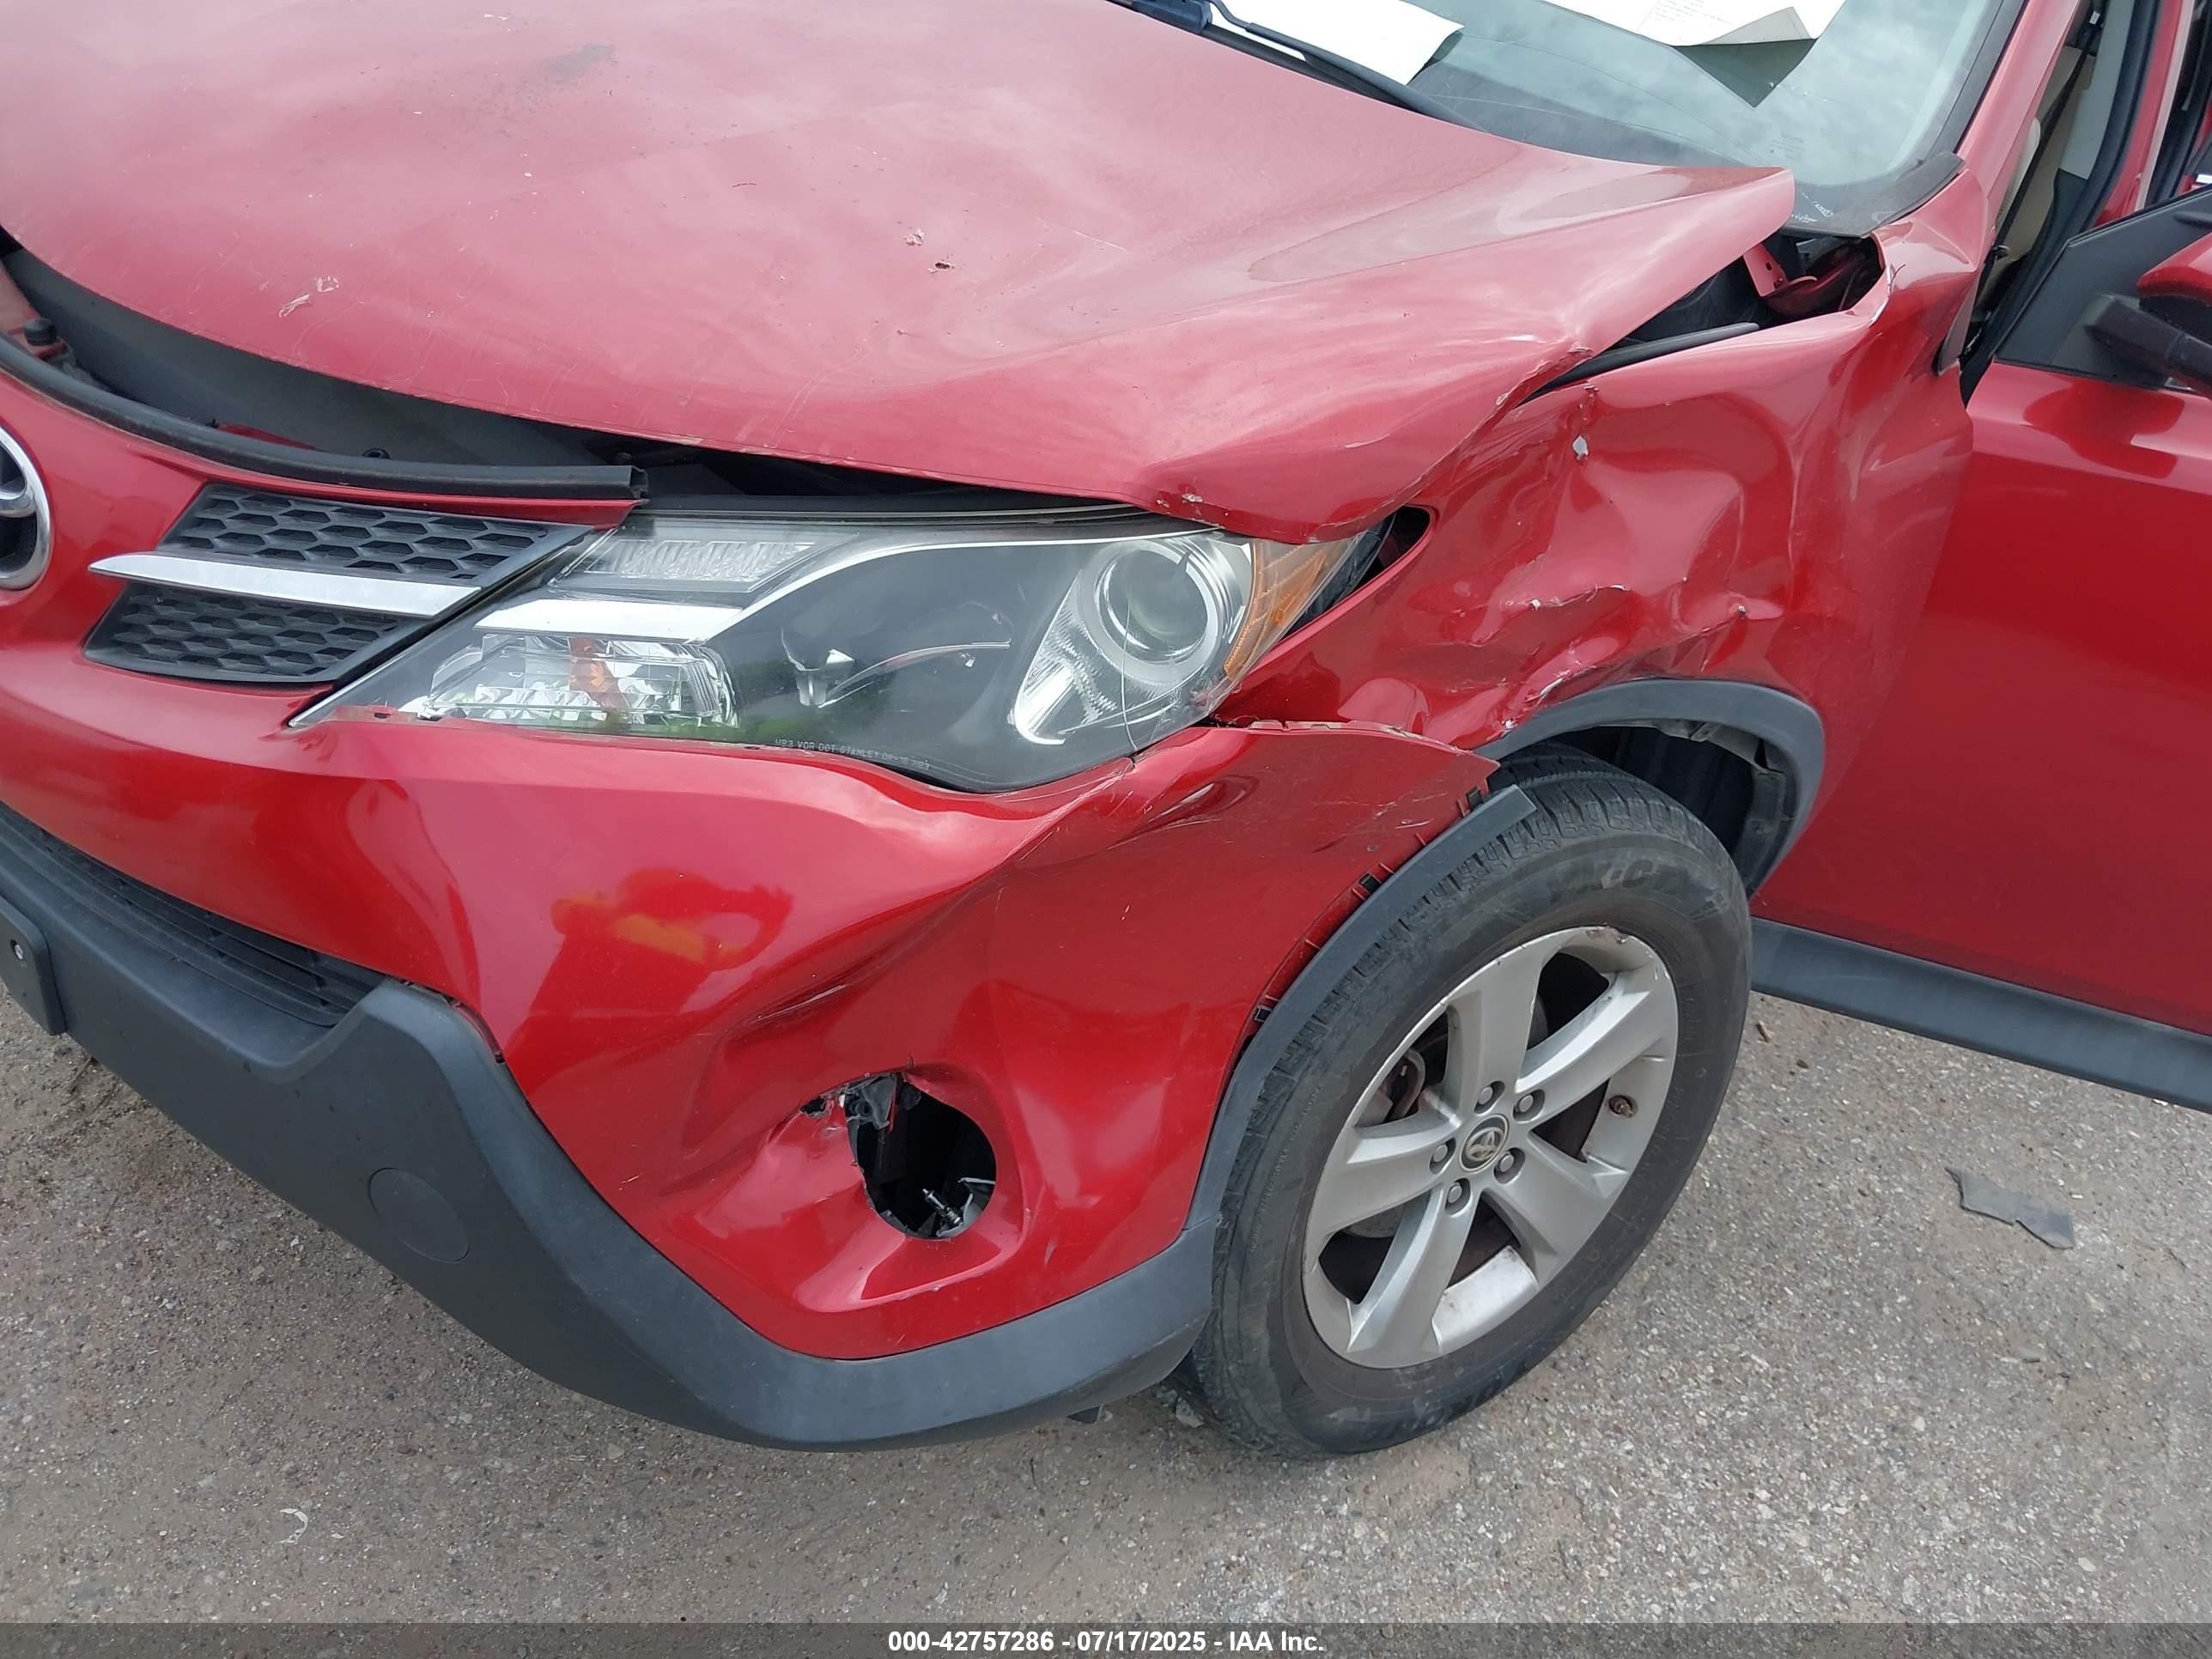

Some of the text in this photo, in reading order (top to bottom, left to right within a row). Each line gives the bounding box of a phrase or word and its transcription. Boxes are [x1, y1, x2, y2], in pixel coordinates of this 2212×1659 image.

[797, 740, 815, 750] VOR
[818, 742, 836, 752] DOT
[840, 744, 880, 758] STANLEY
